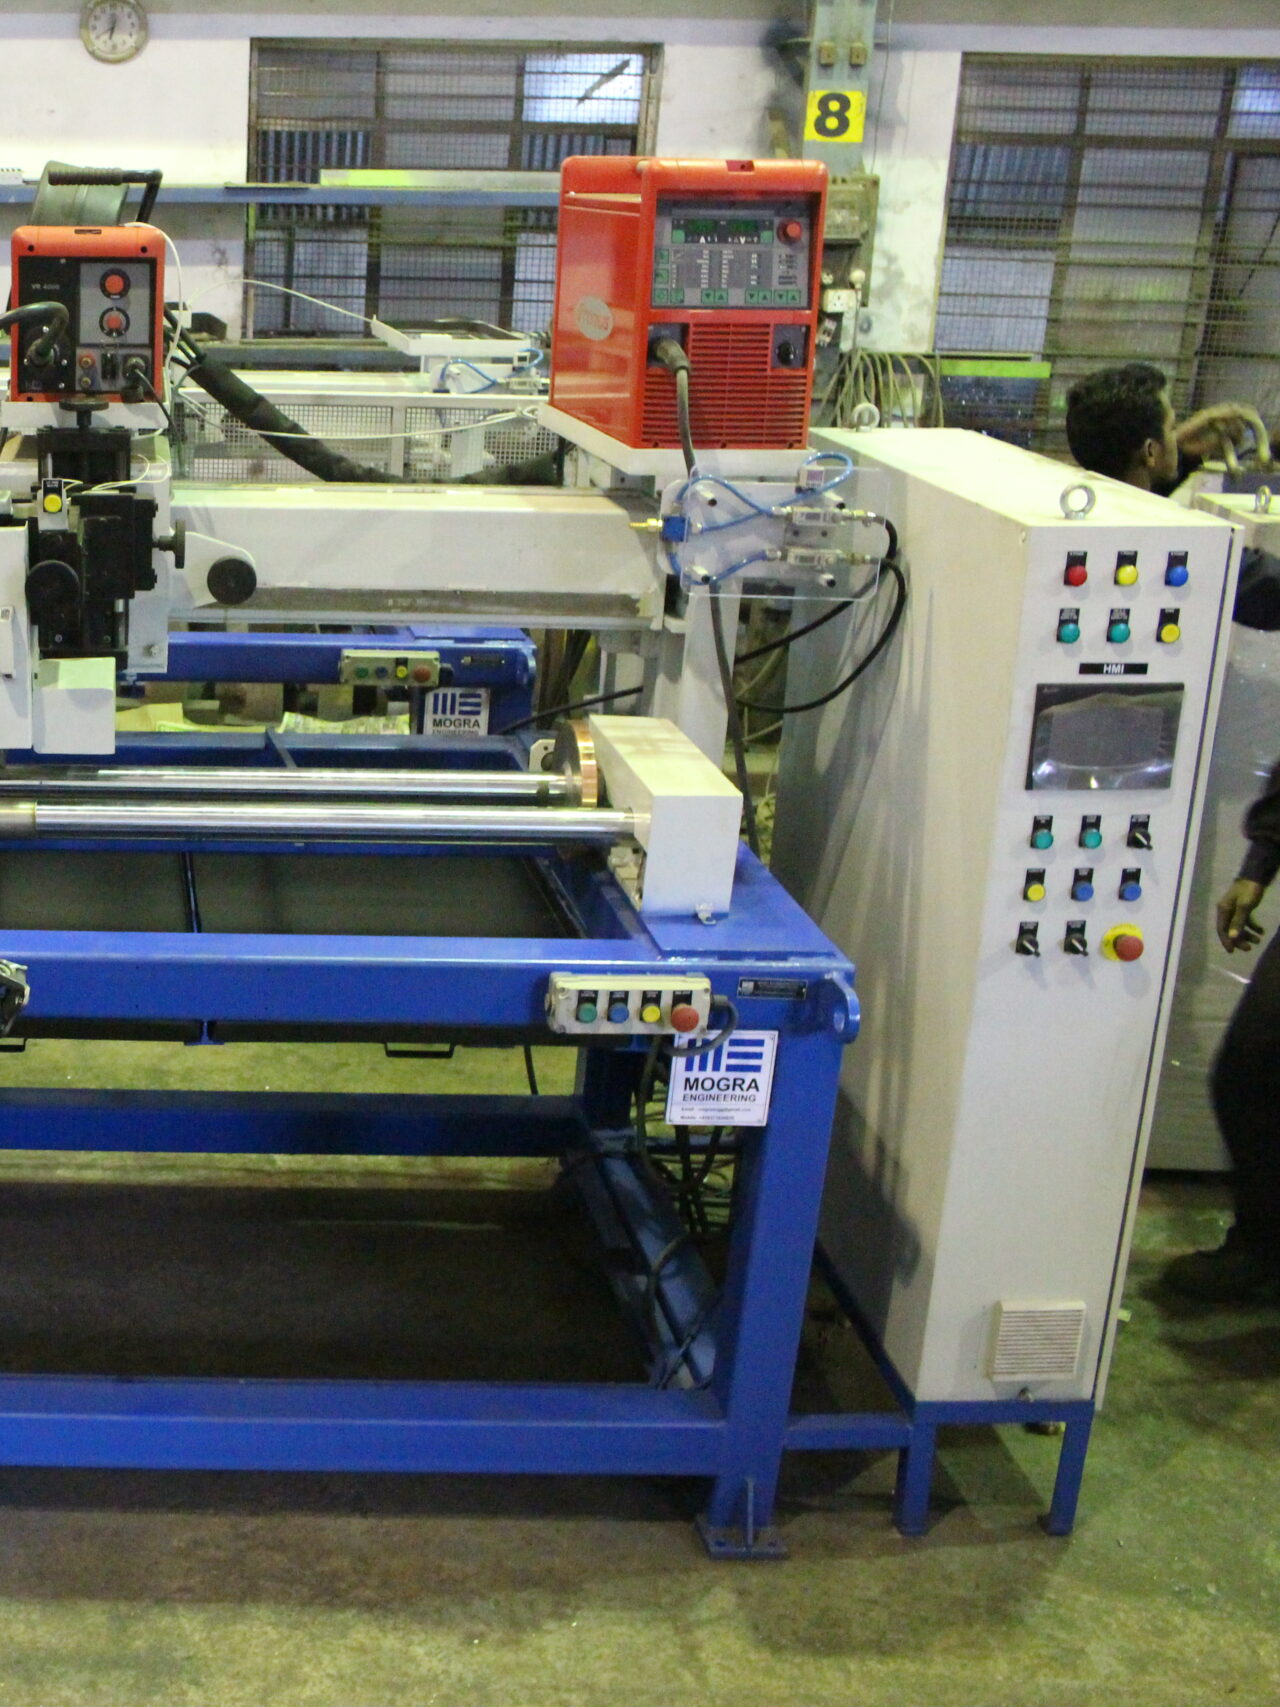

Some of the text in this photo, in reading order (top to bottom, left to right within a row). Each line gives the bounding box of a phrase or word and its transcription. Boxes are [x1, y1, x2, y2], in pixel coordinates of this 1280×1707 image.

[814, 92, 851, 137] 8
[1103, 663, 1125, 675] HMI
[432, 718, 480, 729] MOGRA
[683, 1077, 760, 1092] MOGRA
[682, 1093, 757, 1103] ENGINEERING
